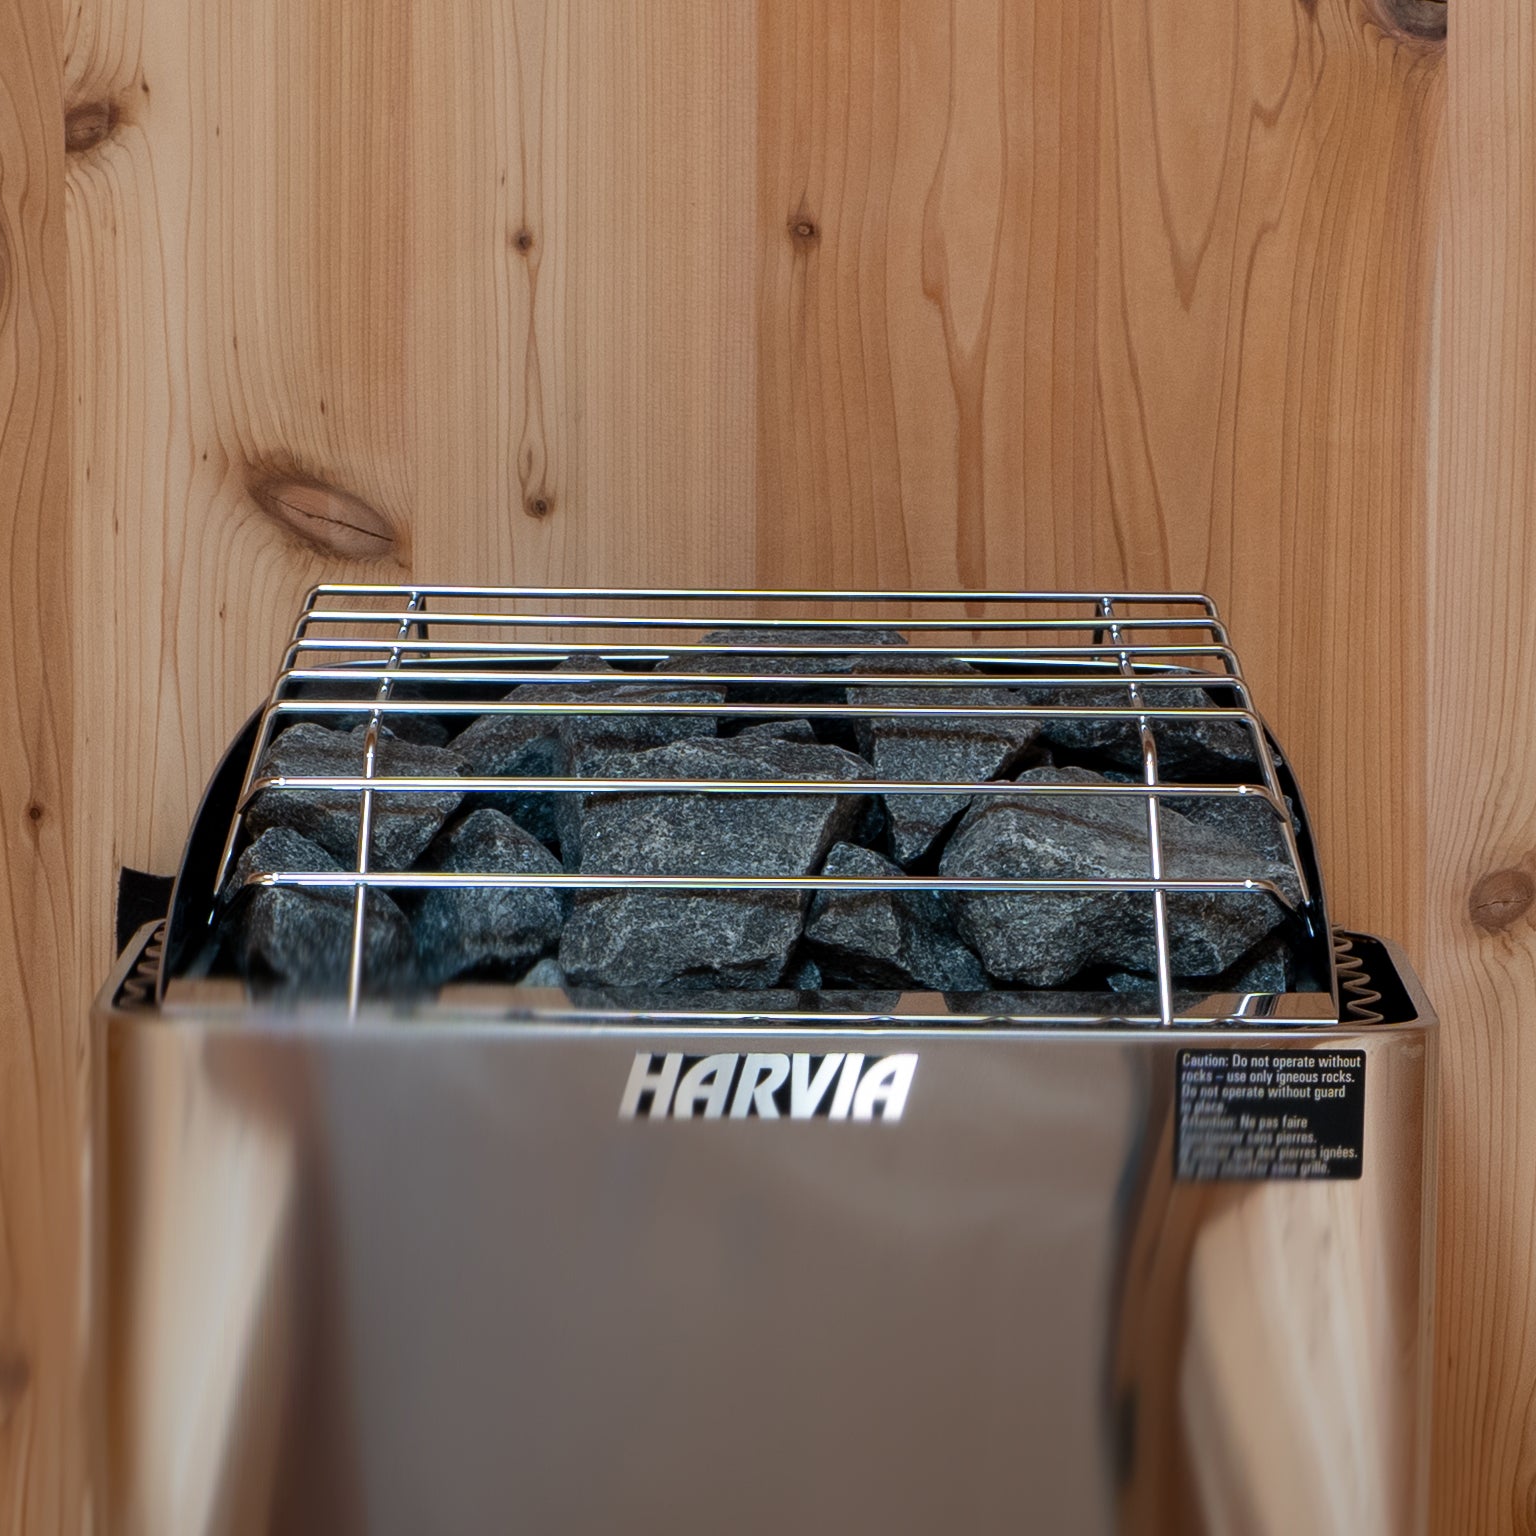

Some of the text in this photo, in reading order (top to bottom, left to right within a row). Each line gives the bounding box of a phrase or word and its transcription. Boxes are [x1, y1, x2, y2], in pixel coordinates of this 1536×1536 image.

[1183, 1054, 1361, 1069] Caution: Do not operate without
[1182, 1071, 1355, 1084] rocks use only igneous rocks.
[619, 1052, 919, 1121] HARVIA
[1200, 1086, 1218, 1097] not
[1222, 1086, 1264, 1100] operate
[1268, 1086, 1311, 1097] without
[1315, 1086, 1346, 1100] guard
[1240, 1116, 1308, 1130] Ne pas faire
[1320, 1147, 1357, 1160] ignées.
